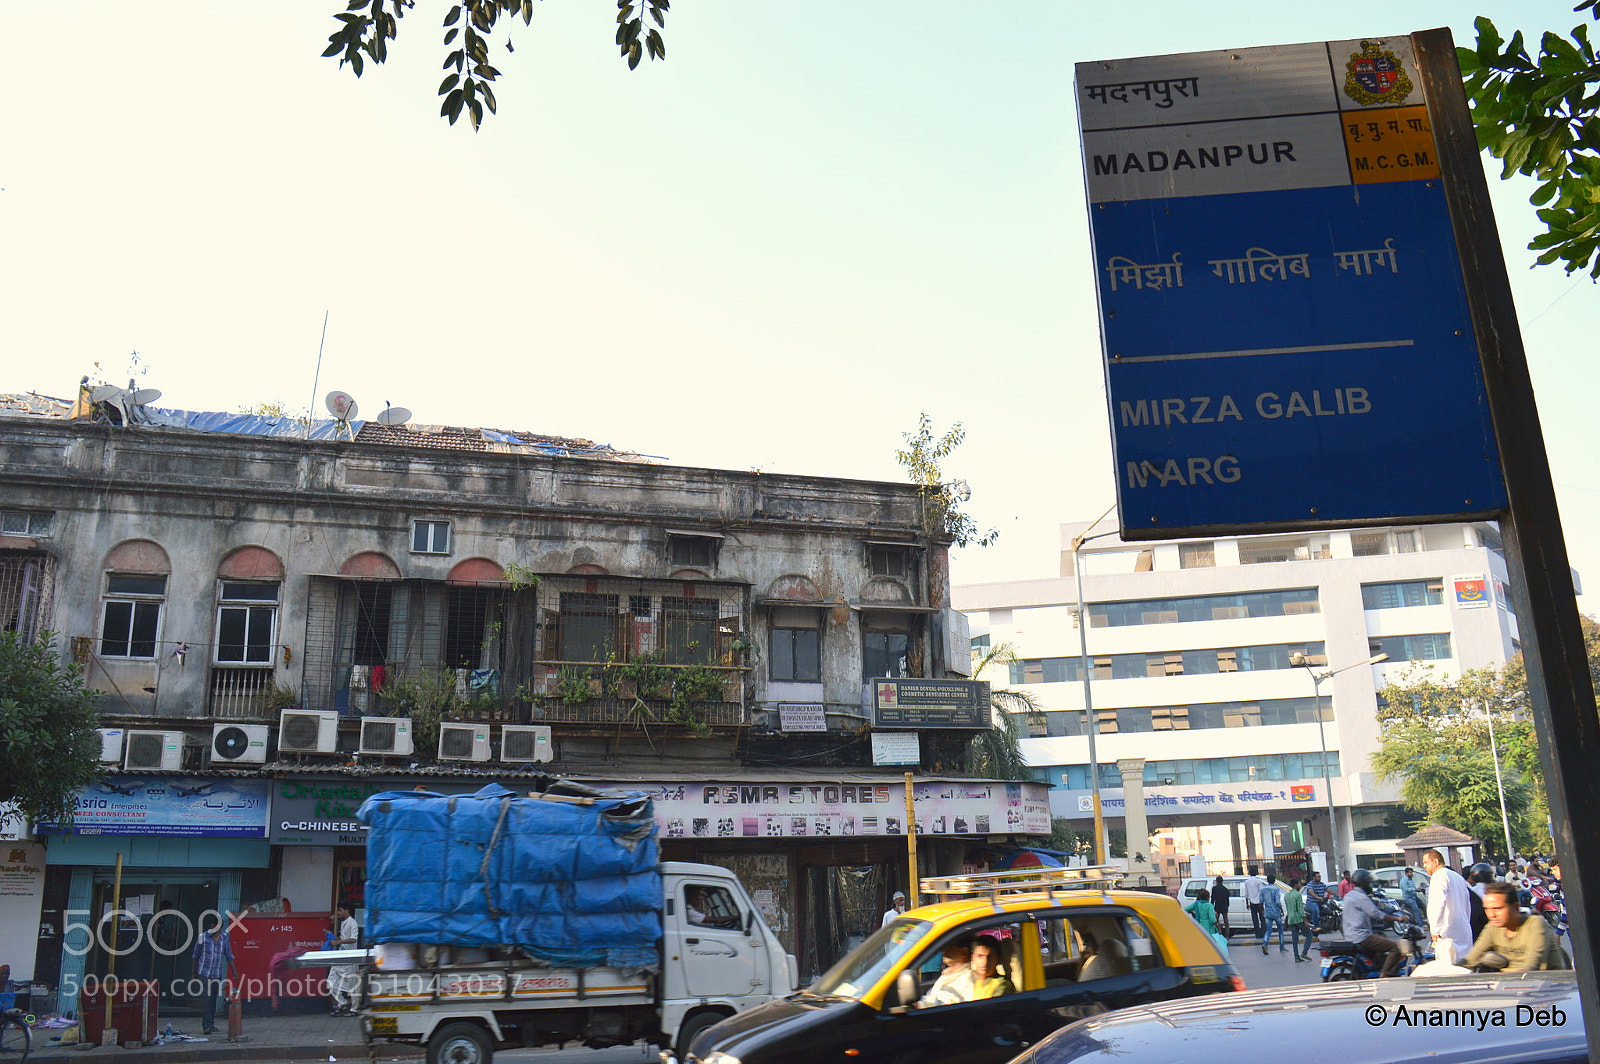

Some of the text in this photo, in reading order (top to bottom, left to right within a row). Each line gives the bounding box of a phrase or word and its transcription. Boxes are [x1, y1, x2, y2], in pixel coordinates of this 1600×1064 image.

[1085, 77, 1199, 108] मदनपुरा
[1093, 140, 1297, 176] MADANPUR
[1106, 238, 1398, 291] मिर्झा गालिब मार्ग
[1120, 387, 1373, 427] MIRZA GALIB
[1126, 455, 1242, 489] MARG
[111, 802, 148, 810] Enterprises
[703, 786, 890, 804] ASMA STORES
[299, 821, 357, 831] CHINESE
